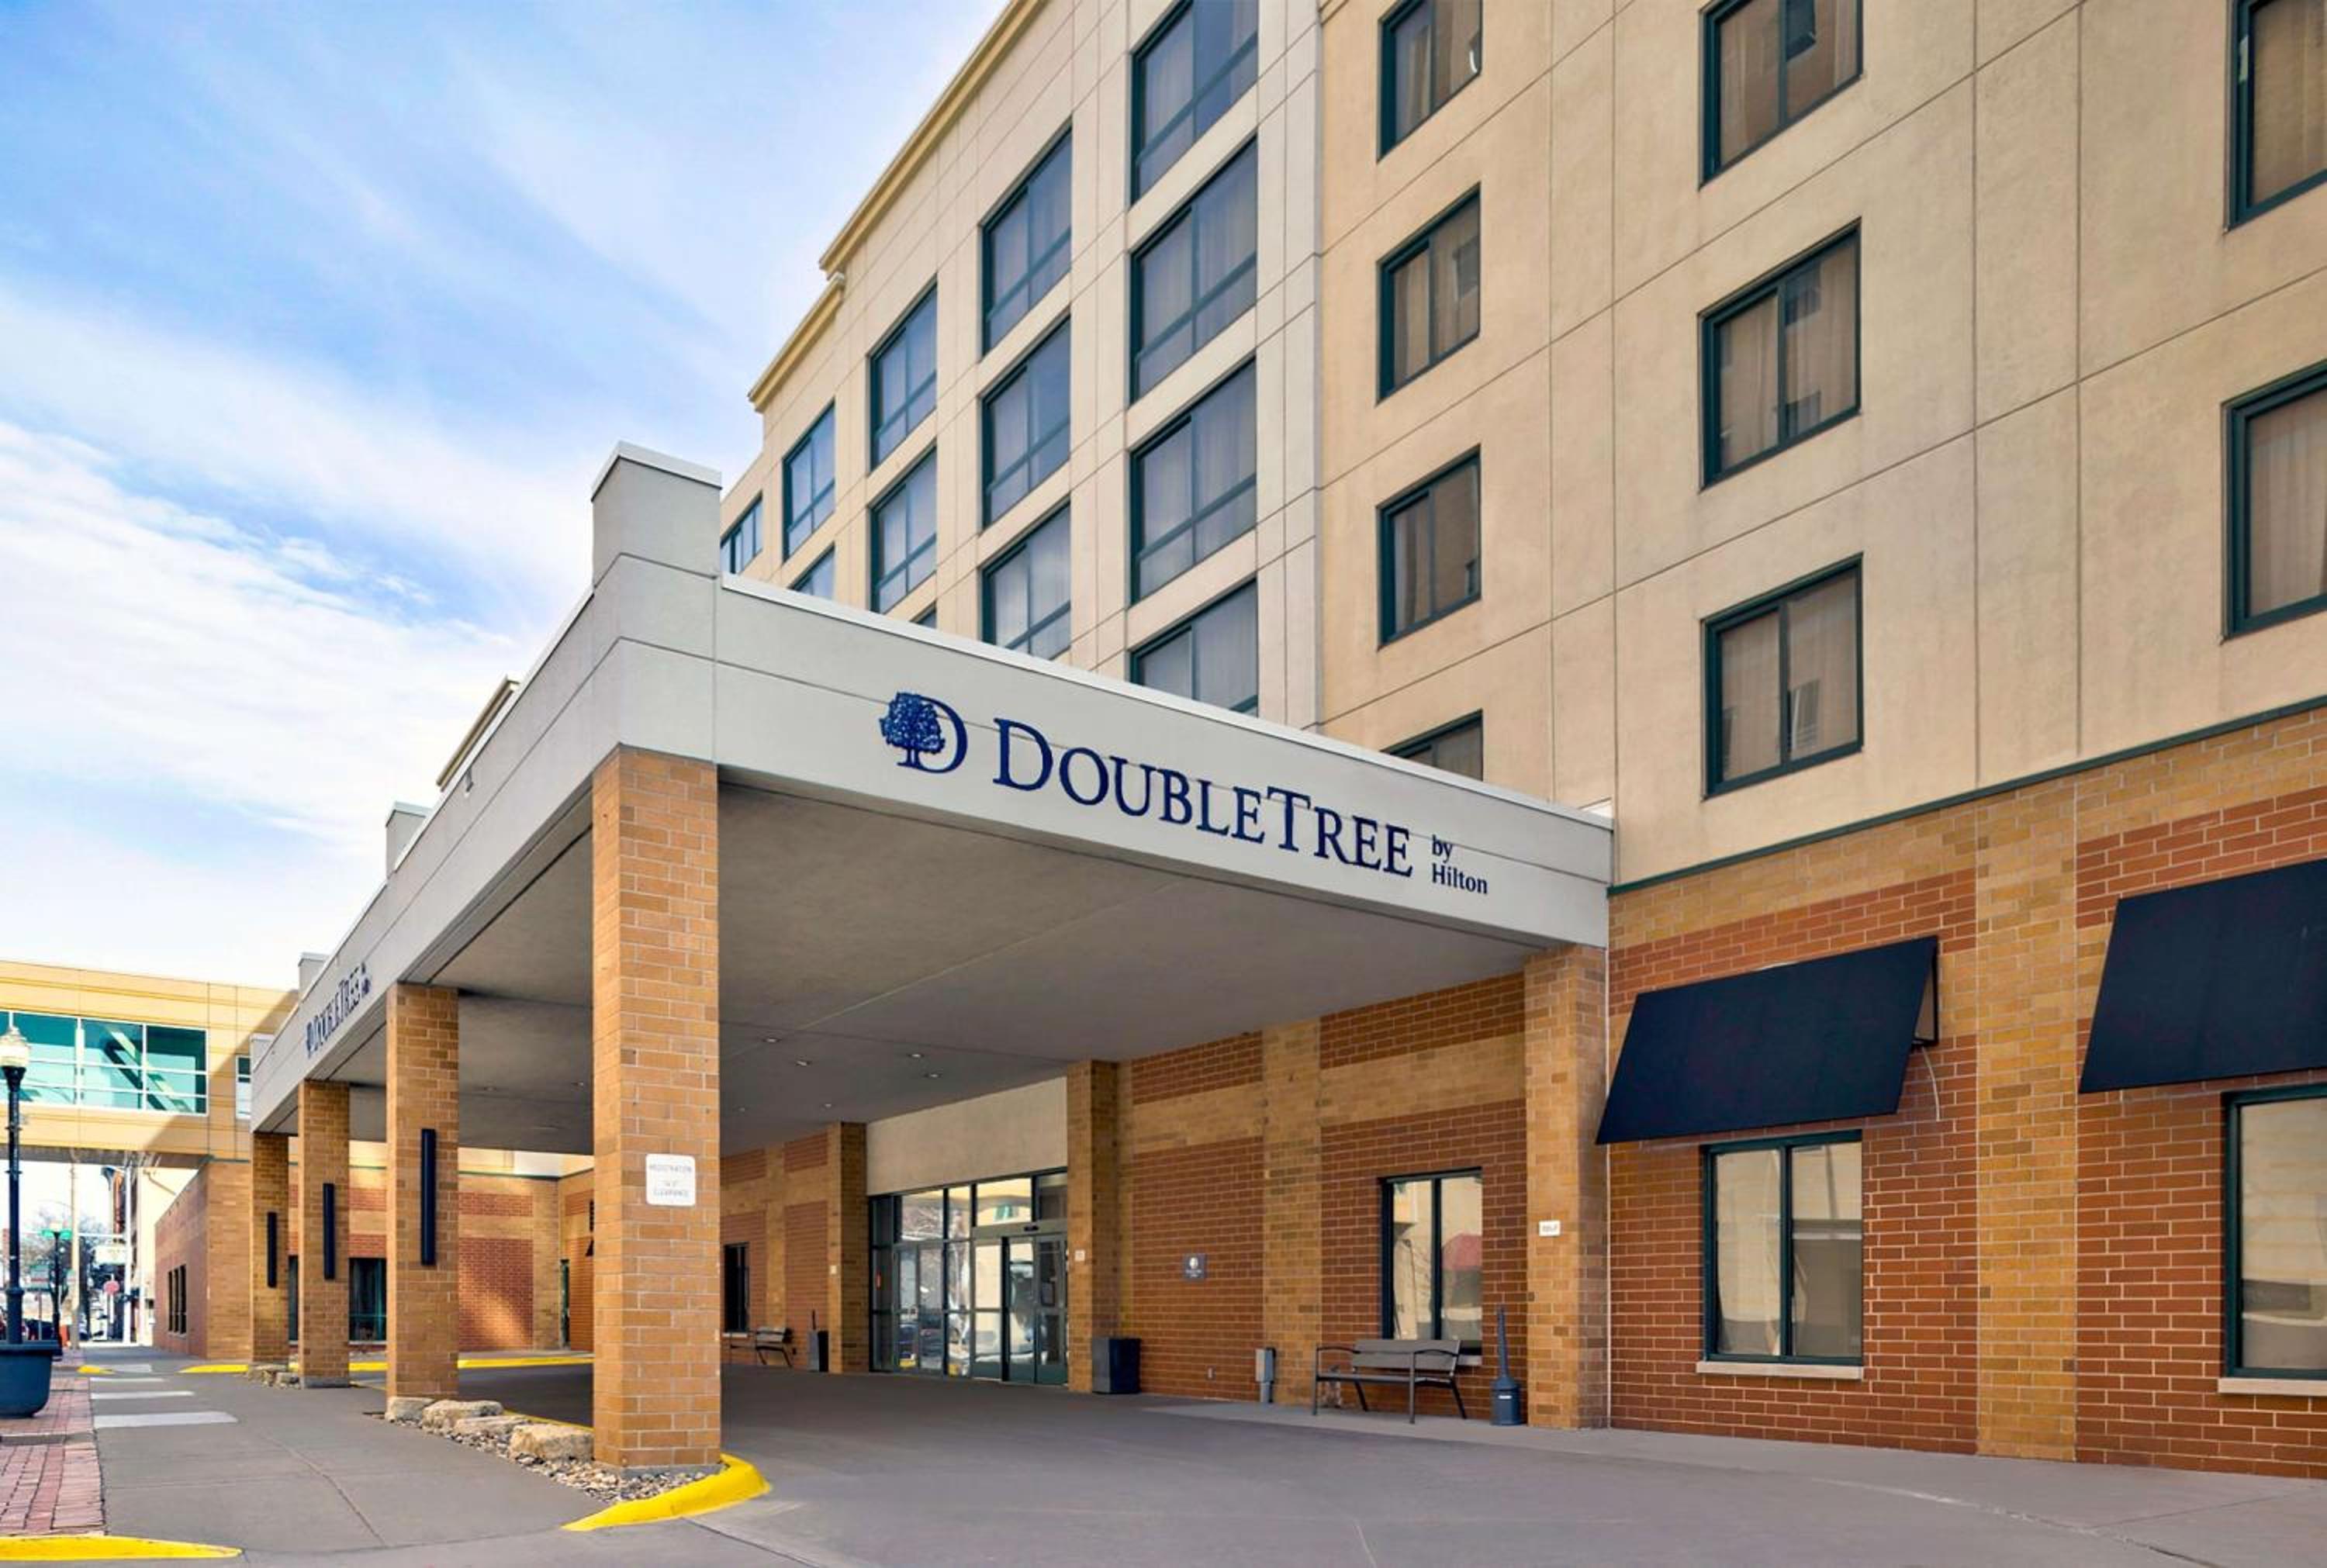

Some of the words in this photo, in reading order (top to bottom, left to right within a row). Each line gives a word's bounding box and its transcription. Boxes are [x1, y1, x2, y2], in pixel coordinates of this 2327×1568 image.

[993, 718, 1413, 877] DOUBLETREE
[1431, 835, 1454, 861] by
[1431, 862, 1489, 895] Hilton
